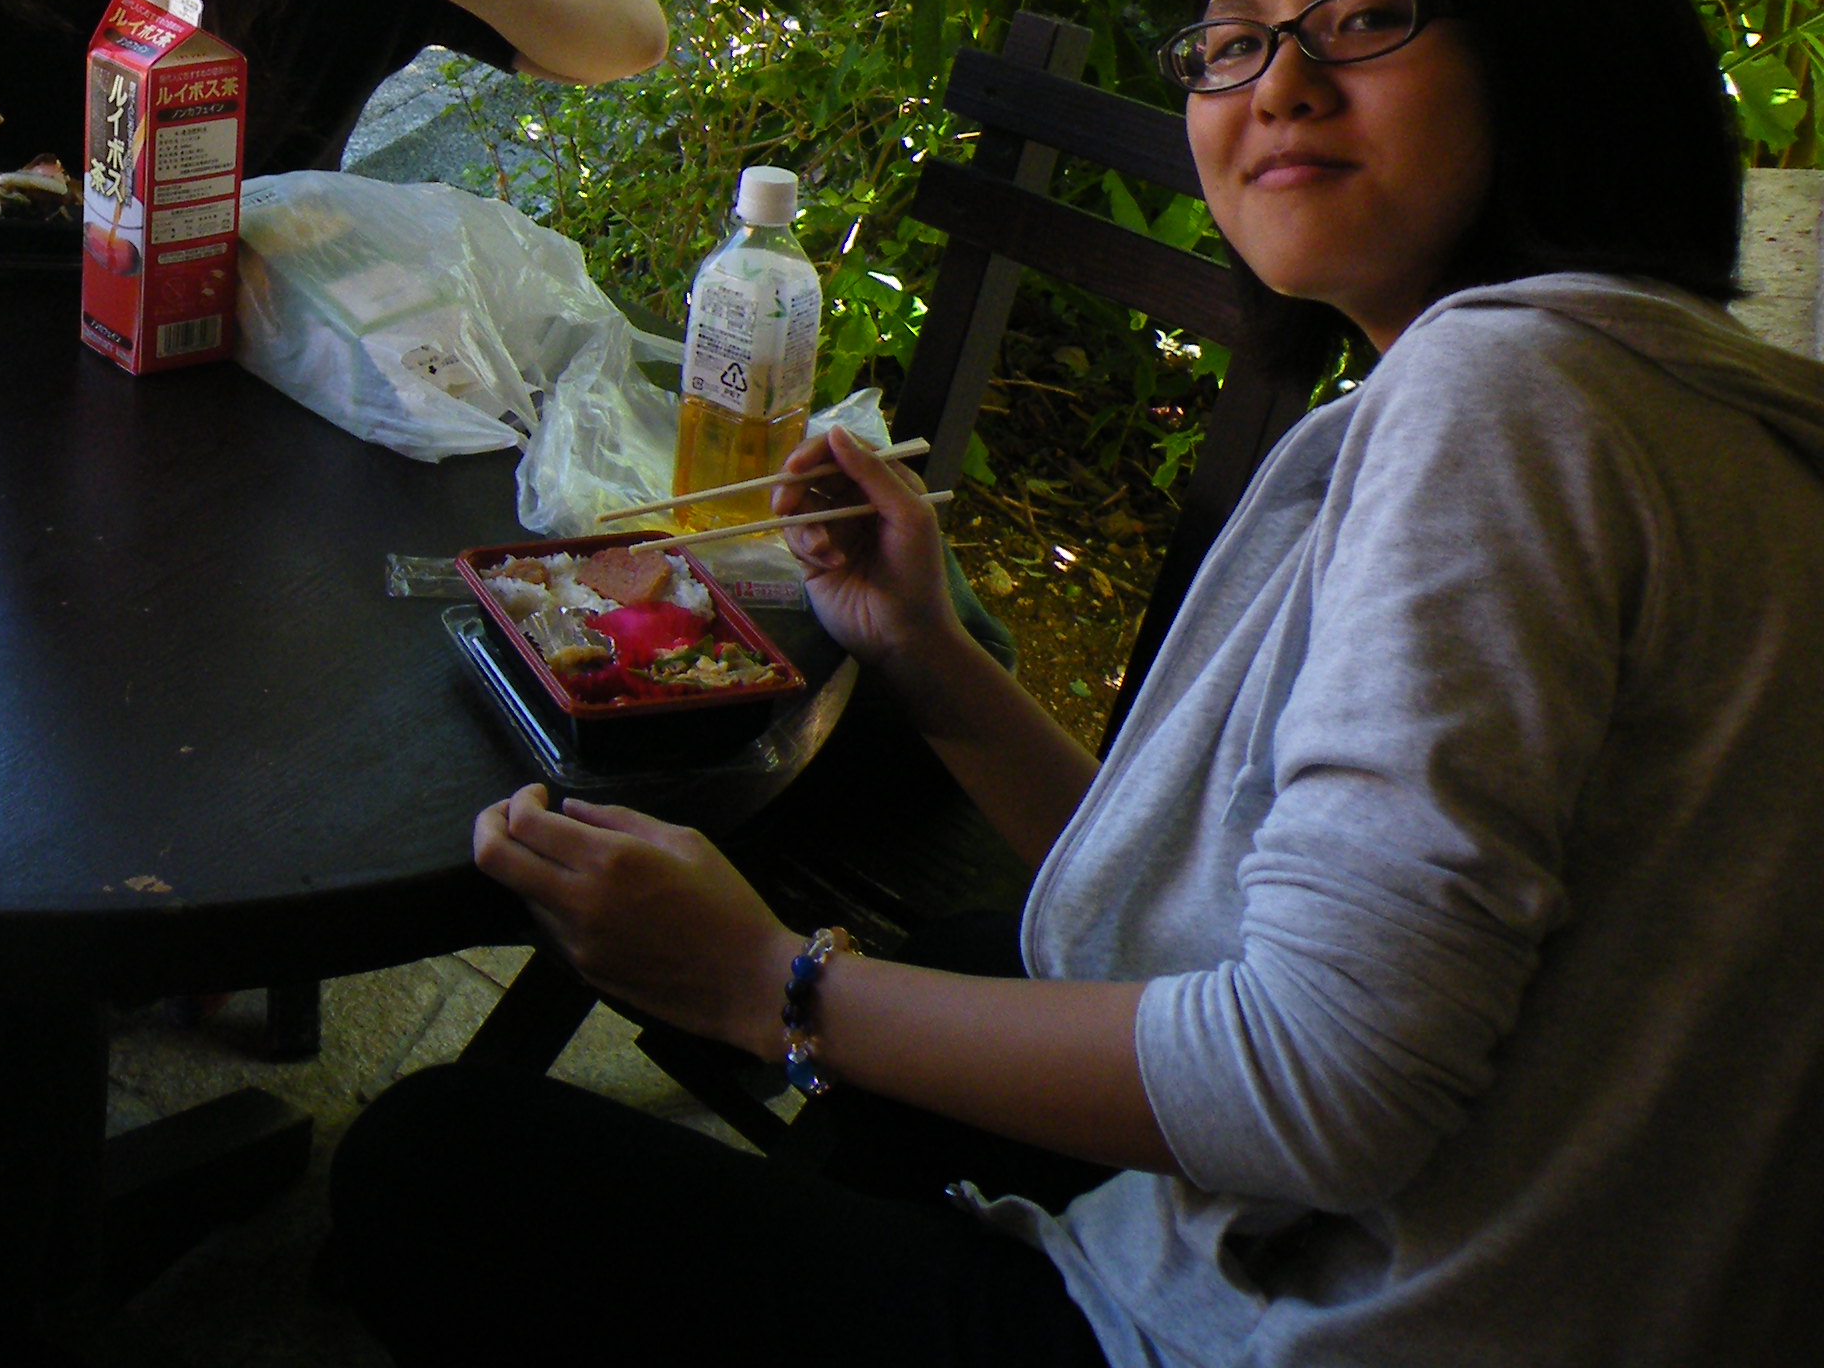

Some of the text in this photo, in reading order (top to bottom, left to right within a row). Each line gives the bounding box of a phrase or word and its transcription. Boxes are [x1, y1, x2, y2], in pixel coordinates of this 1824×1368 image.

[109, 8, 176, 48] ルイボス茶
[155, 76, 239, 106] ルイボス茶
[171, 103, 225, 120] ノンカフェイン
[90, 74, 127, 204] ルイボス茶
